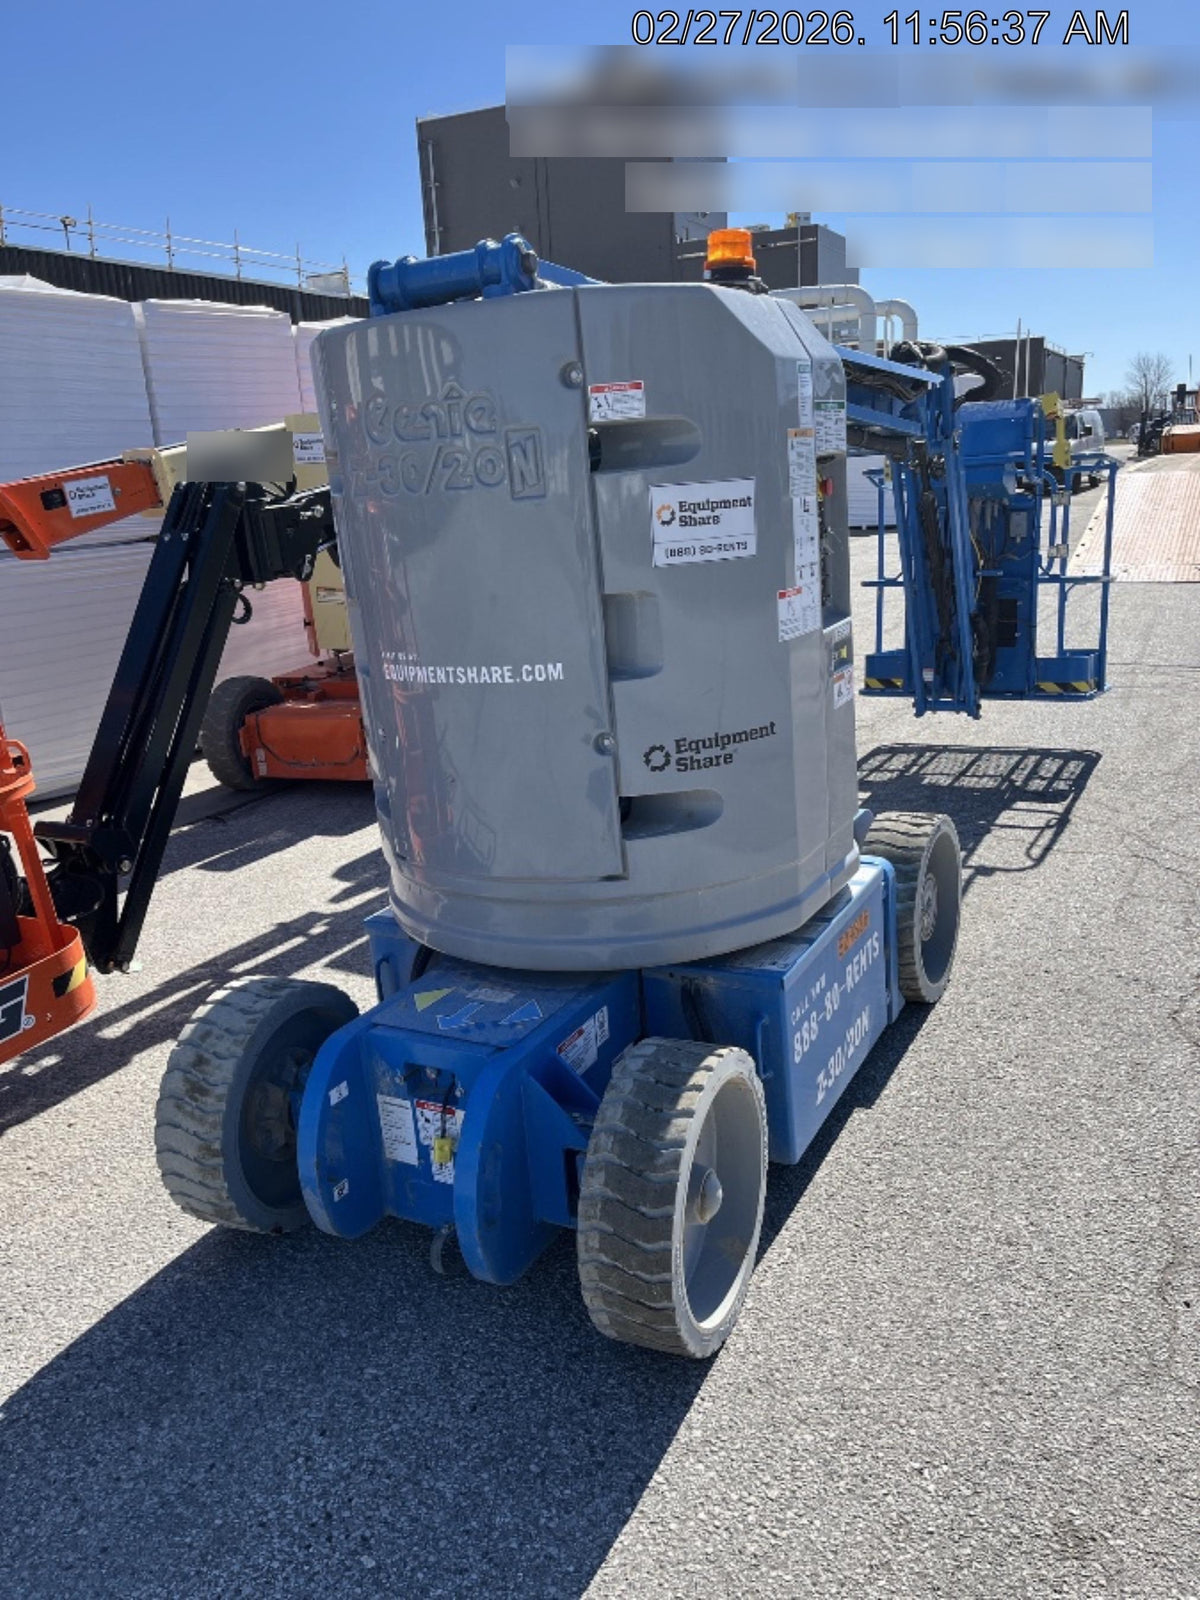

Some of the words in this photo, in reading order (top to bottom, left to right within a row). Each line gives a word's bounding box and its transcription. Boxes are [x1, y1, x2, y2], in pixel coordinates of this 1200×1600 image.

[678, 496, 752, 514] Equipment
[679, 515, 720, 527] Share
[384, 662, 565, 684] EQUIPMENTSHARE.COM
[674, 721, 776, 754] Equipment
[675, 753, 733, 772] Share
